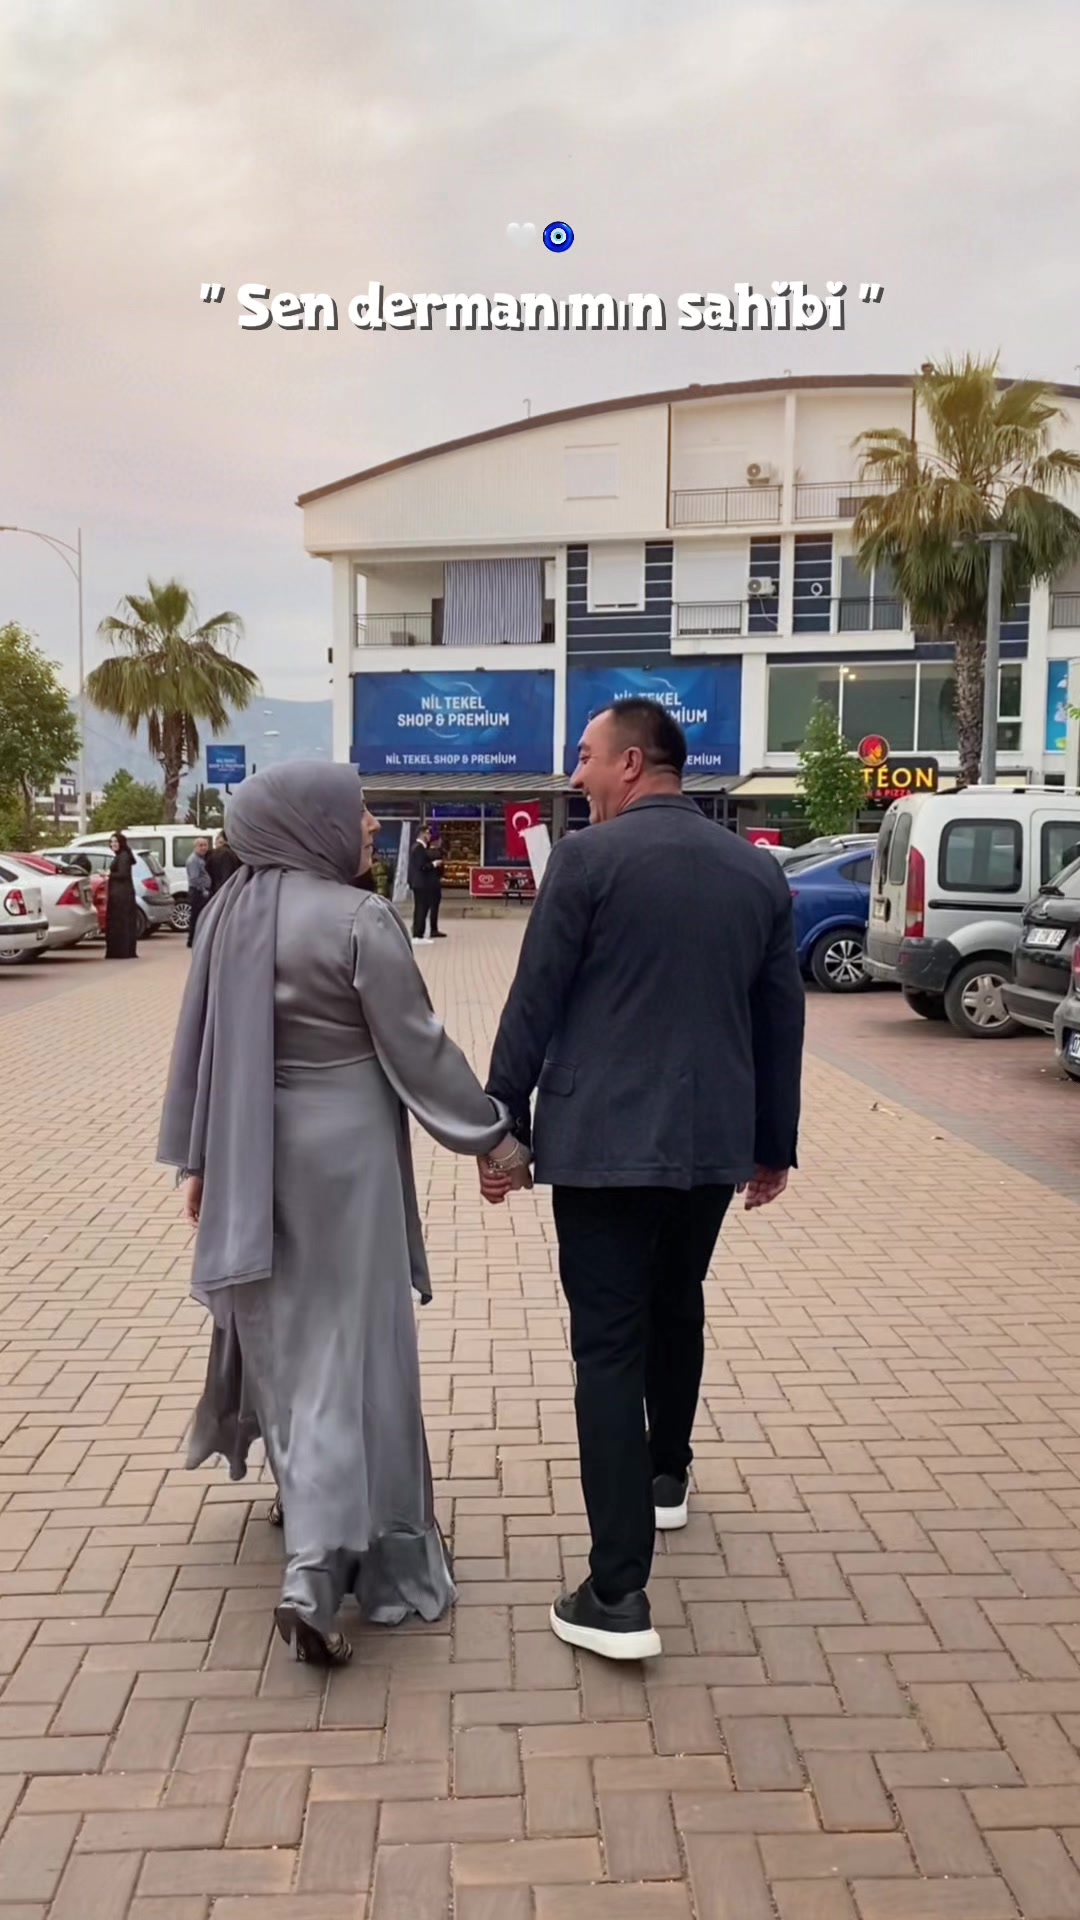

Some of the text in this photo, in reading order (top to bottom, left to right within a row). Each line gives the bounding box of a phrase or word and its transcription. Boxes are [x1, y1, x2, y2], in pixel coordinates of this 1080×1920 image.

[421, 693, 486, 710] NİL TEKEL
[397, 710, 510, 727] SHOP & PREMİUM
[669, 706, 708, 723] MİUM
[385, 752, 517, 765] NİL TEKEL SHOP & PREMİUM
[686, 753, 722, 766] EMİUM
[859, 764, 934, 788] TÉON
